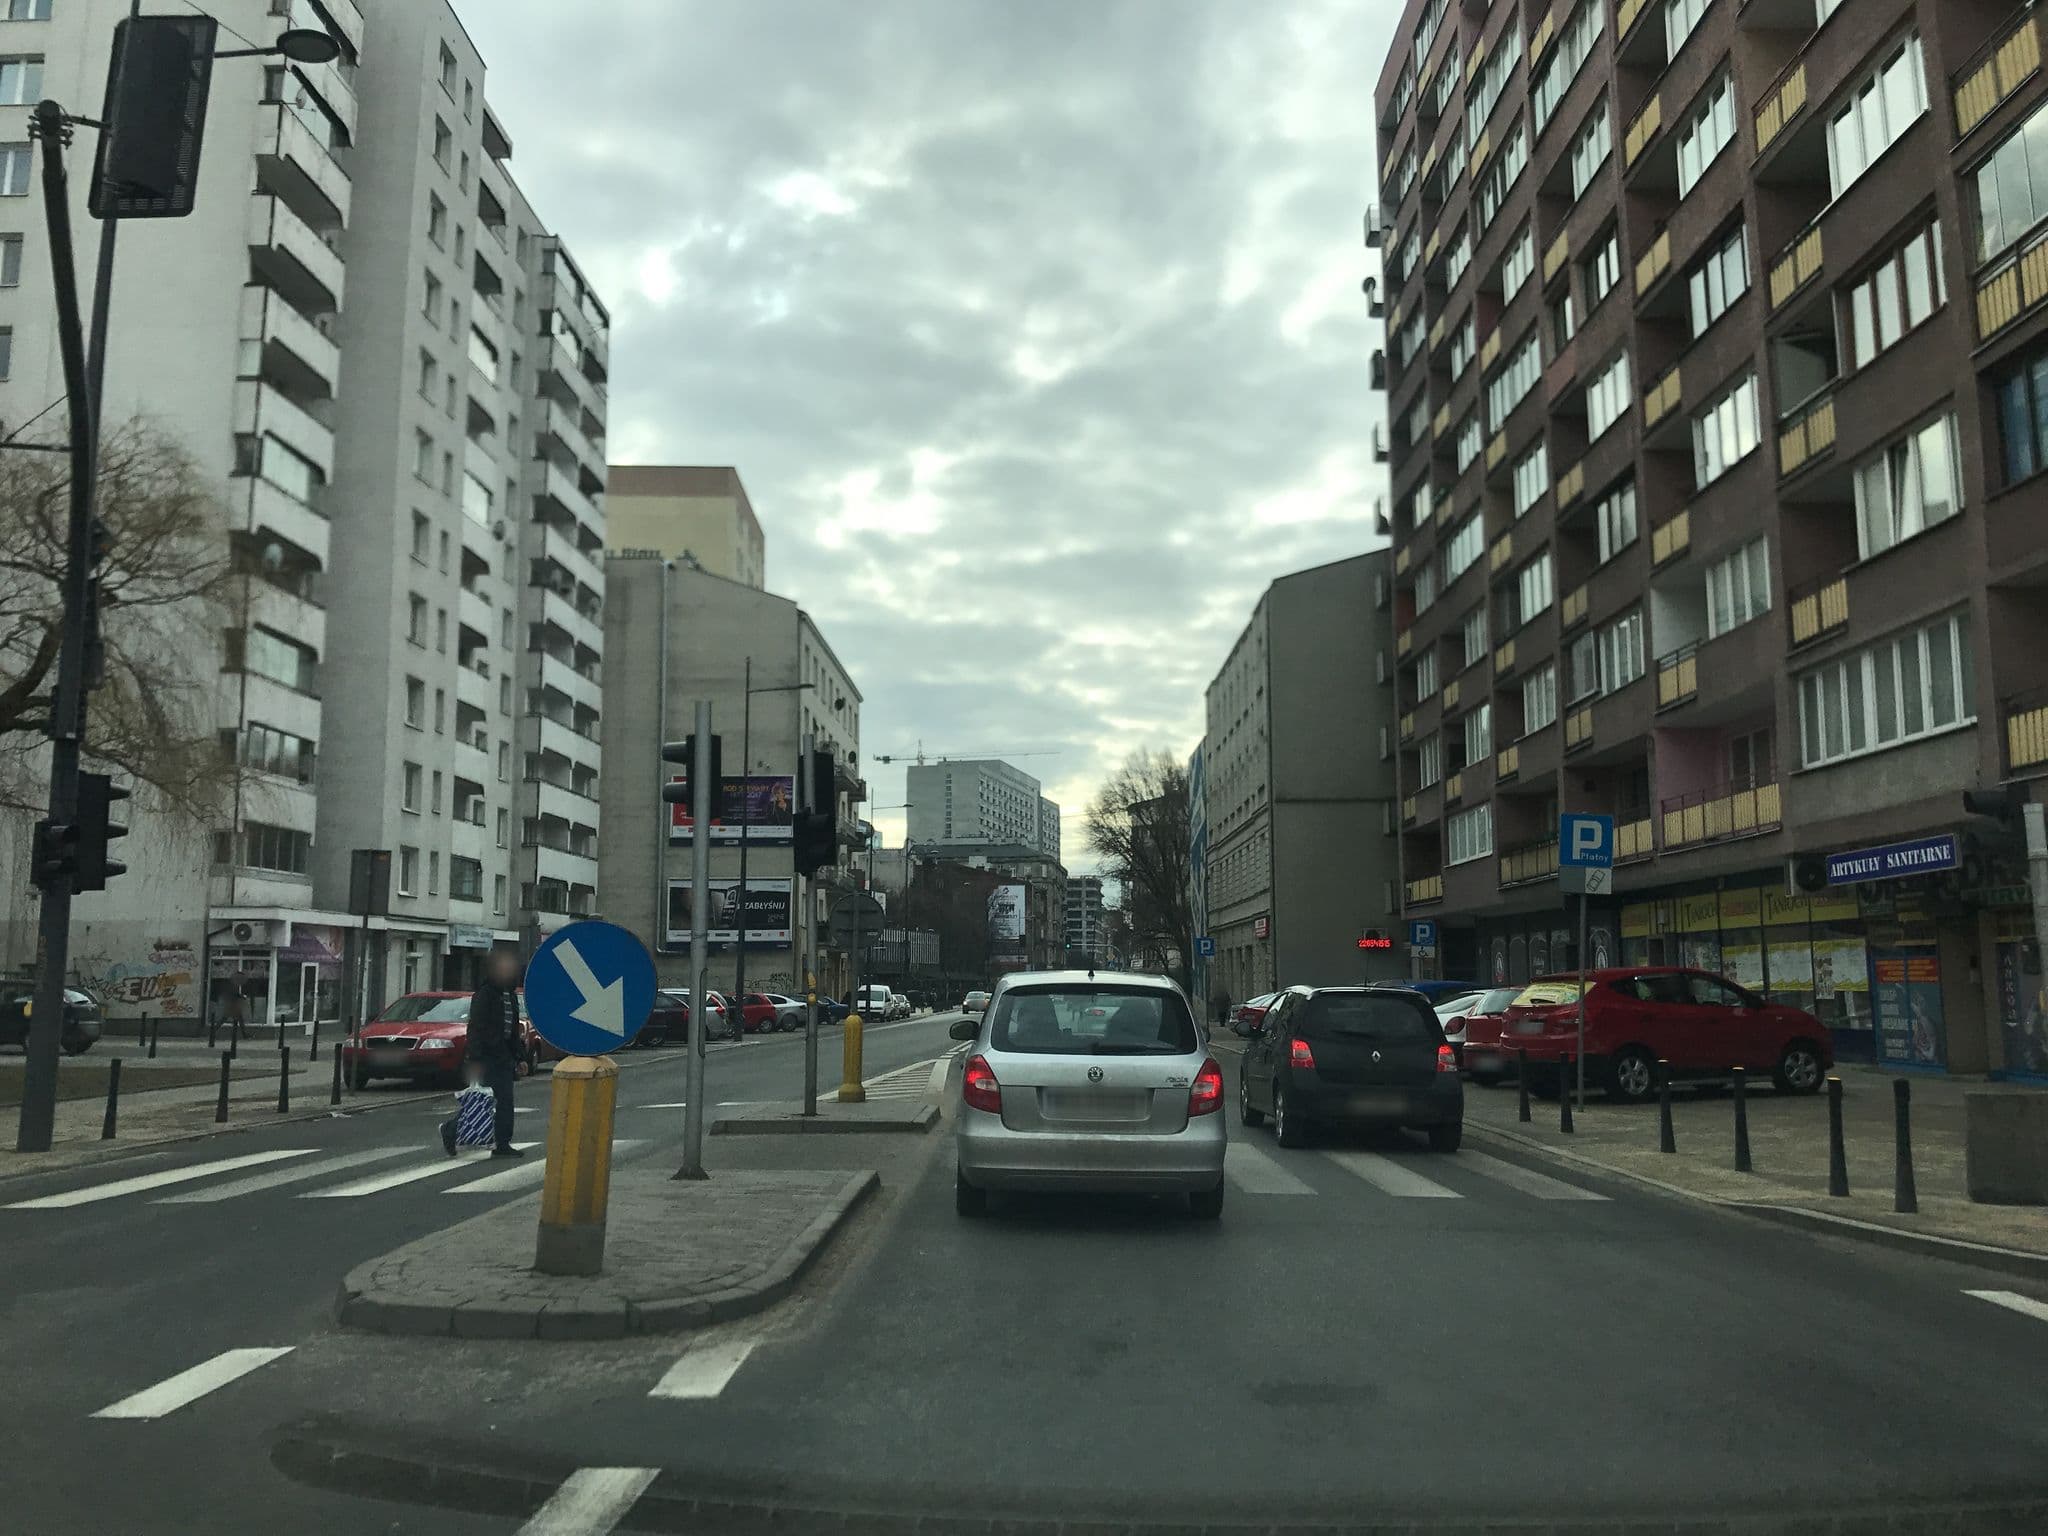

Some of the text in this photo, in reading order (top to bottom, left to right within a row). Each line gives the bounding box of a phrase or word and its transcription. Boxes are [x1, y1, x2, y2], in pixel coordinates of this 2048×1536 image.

[1572, 820, 1602, 860] P
[1830, 844, 1951, 877] ARTYKUŁY SANITARNE
[744, 900, 786, 910] ZABŁYŚNIJ
[1415, 924, 1431, 943] P
[1200, 940, 1211, 954] P
